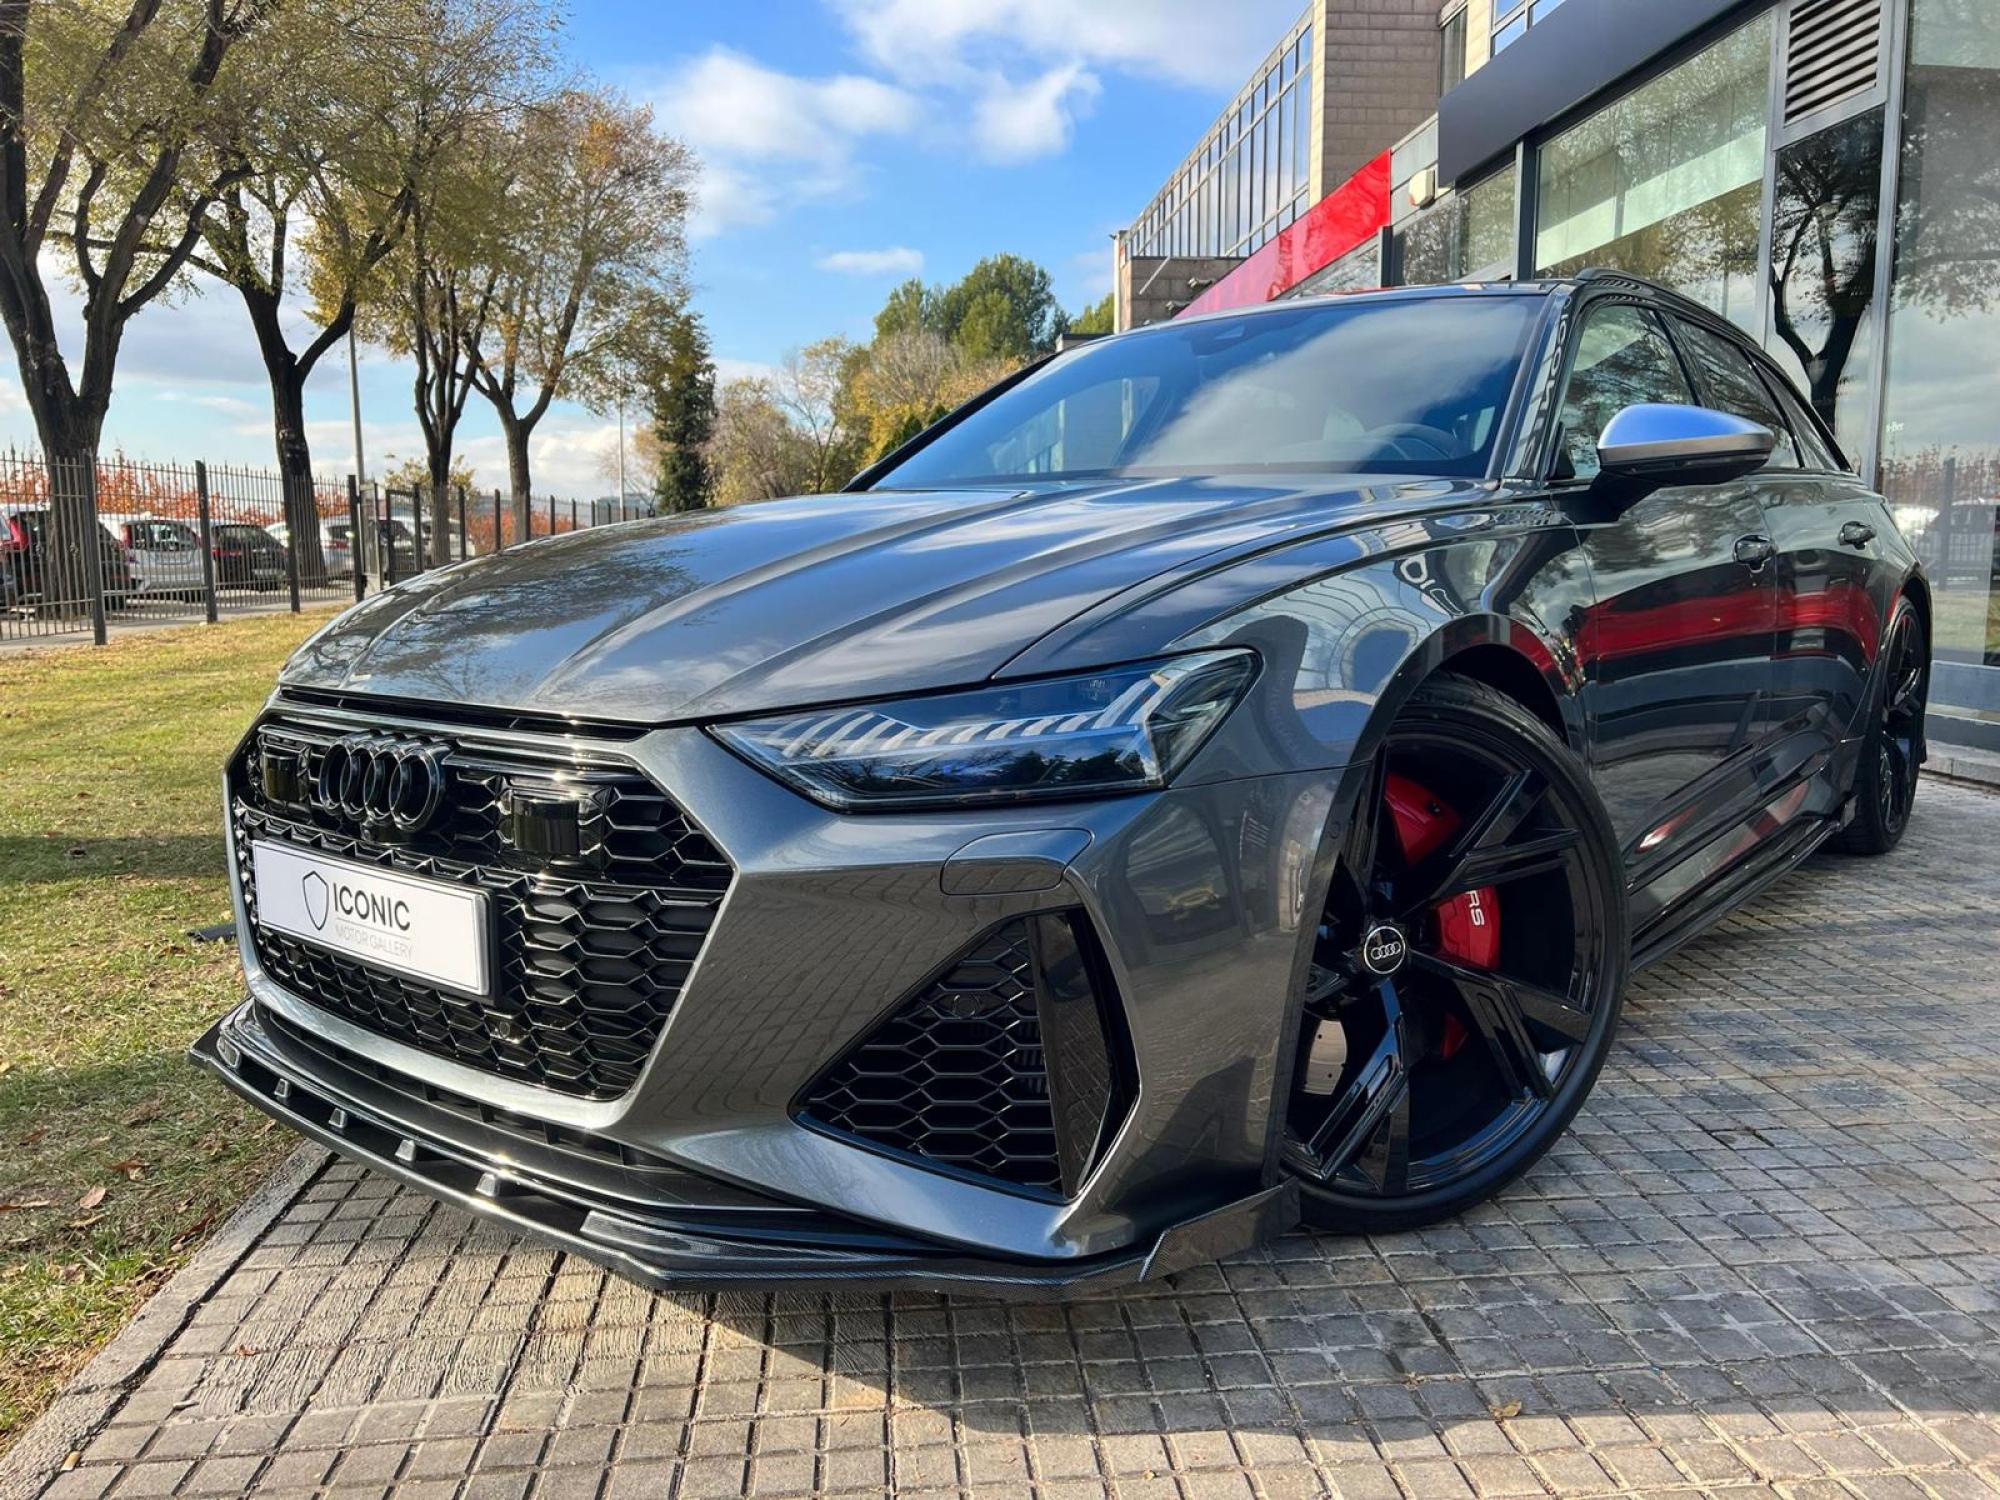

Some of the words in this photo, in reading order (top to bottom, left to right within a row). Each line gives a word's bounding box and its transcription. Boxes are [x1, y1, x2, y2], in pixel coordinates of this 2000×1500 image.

[333, 882, 411, 931] ICONIC
[1465, 889, 1485, 926] RS
[335, 923, 368, 945] MOTOR
[369, 934, 413, 961] GALLERY
